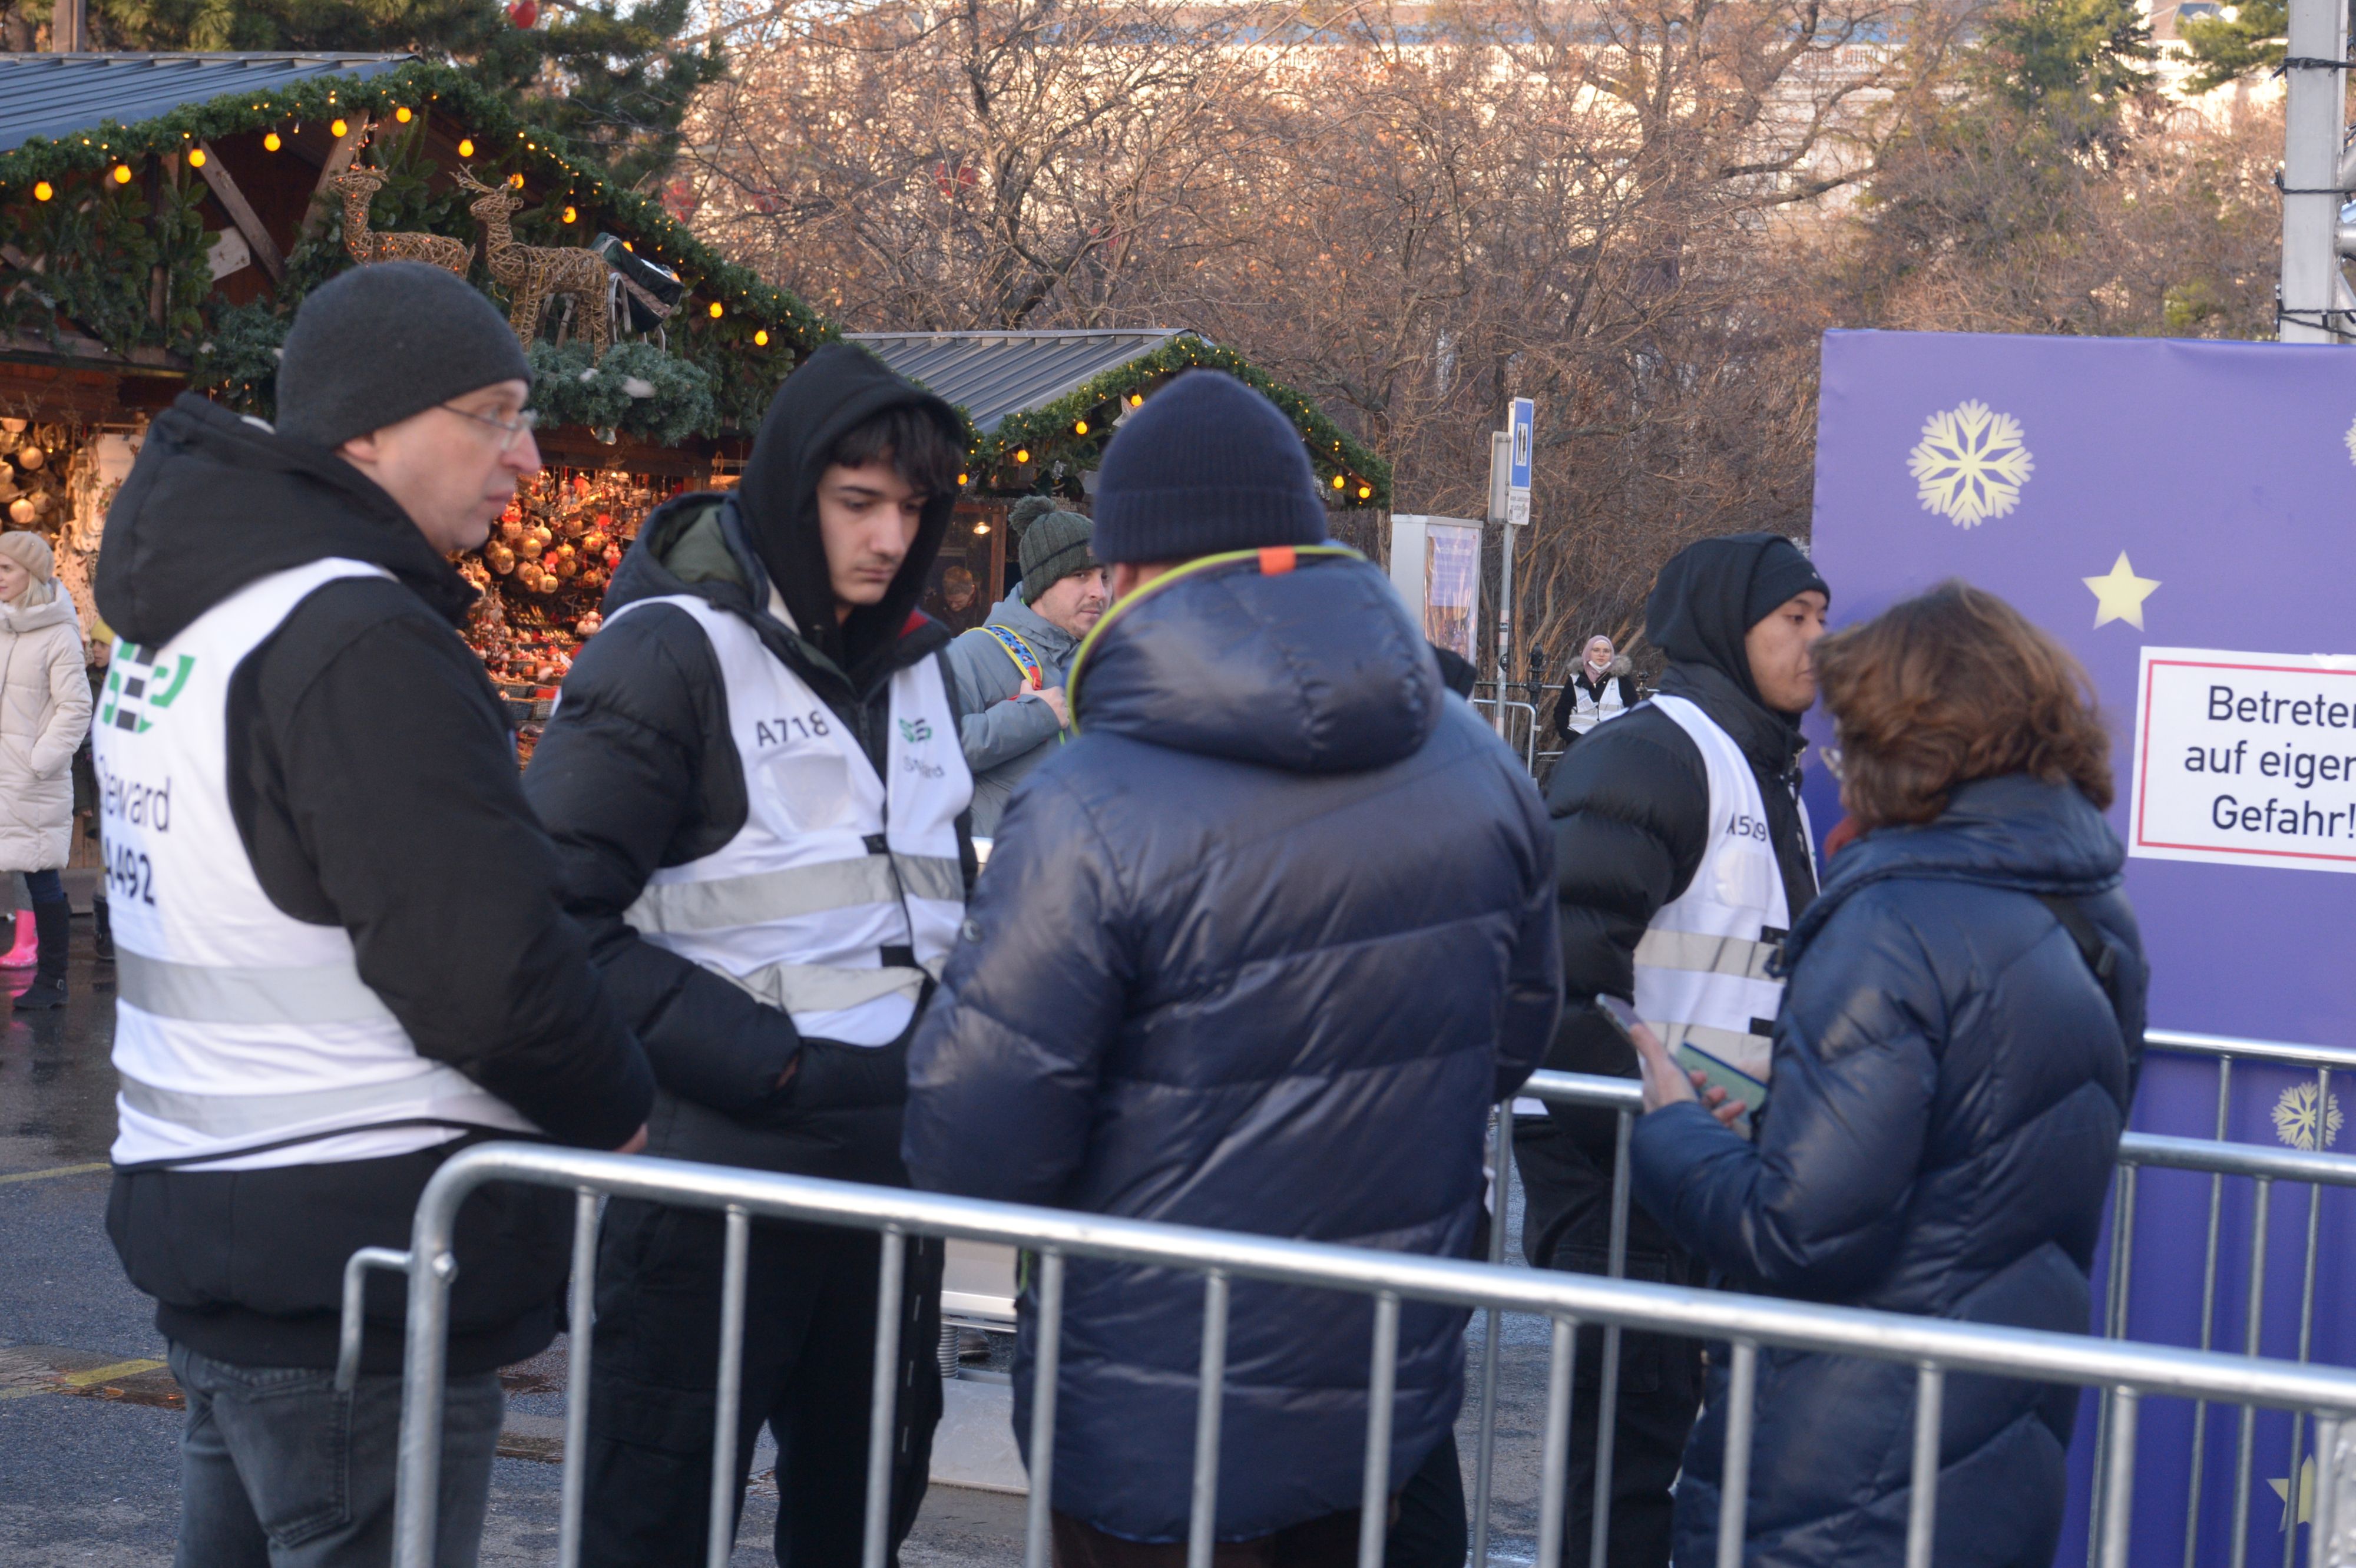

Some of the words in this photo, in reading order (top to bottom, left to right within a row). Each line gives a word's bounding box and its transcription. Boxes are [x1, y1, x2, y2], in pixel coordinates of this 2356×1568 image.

[2208, 685, 2356, 728] Betrete
[756, 710, 829, 746] A718
[2185, 740, 2247, 774] auf
[2212, 795, 2356, 838] Gefahr!
